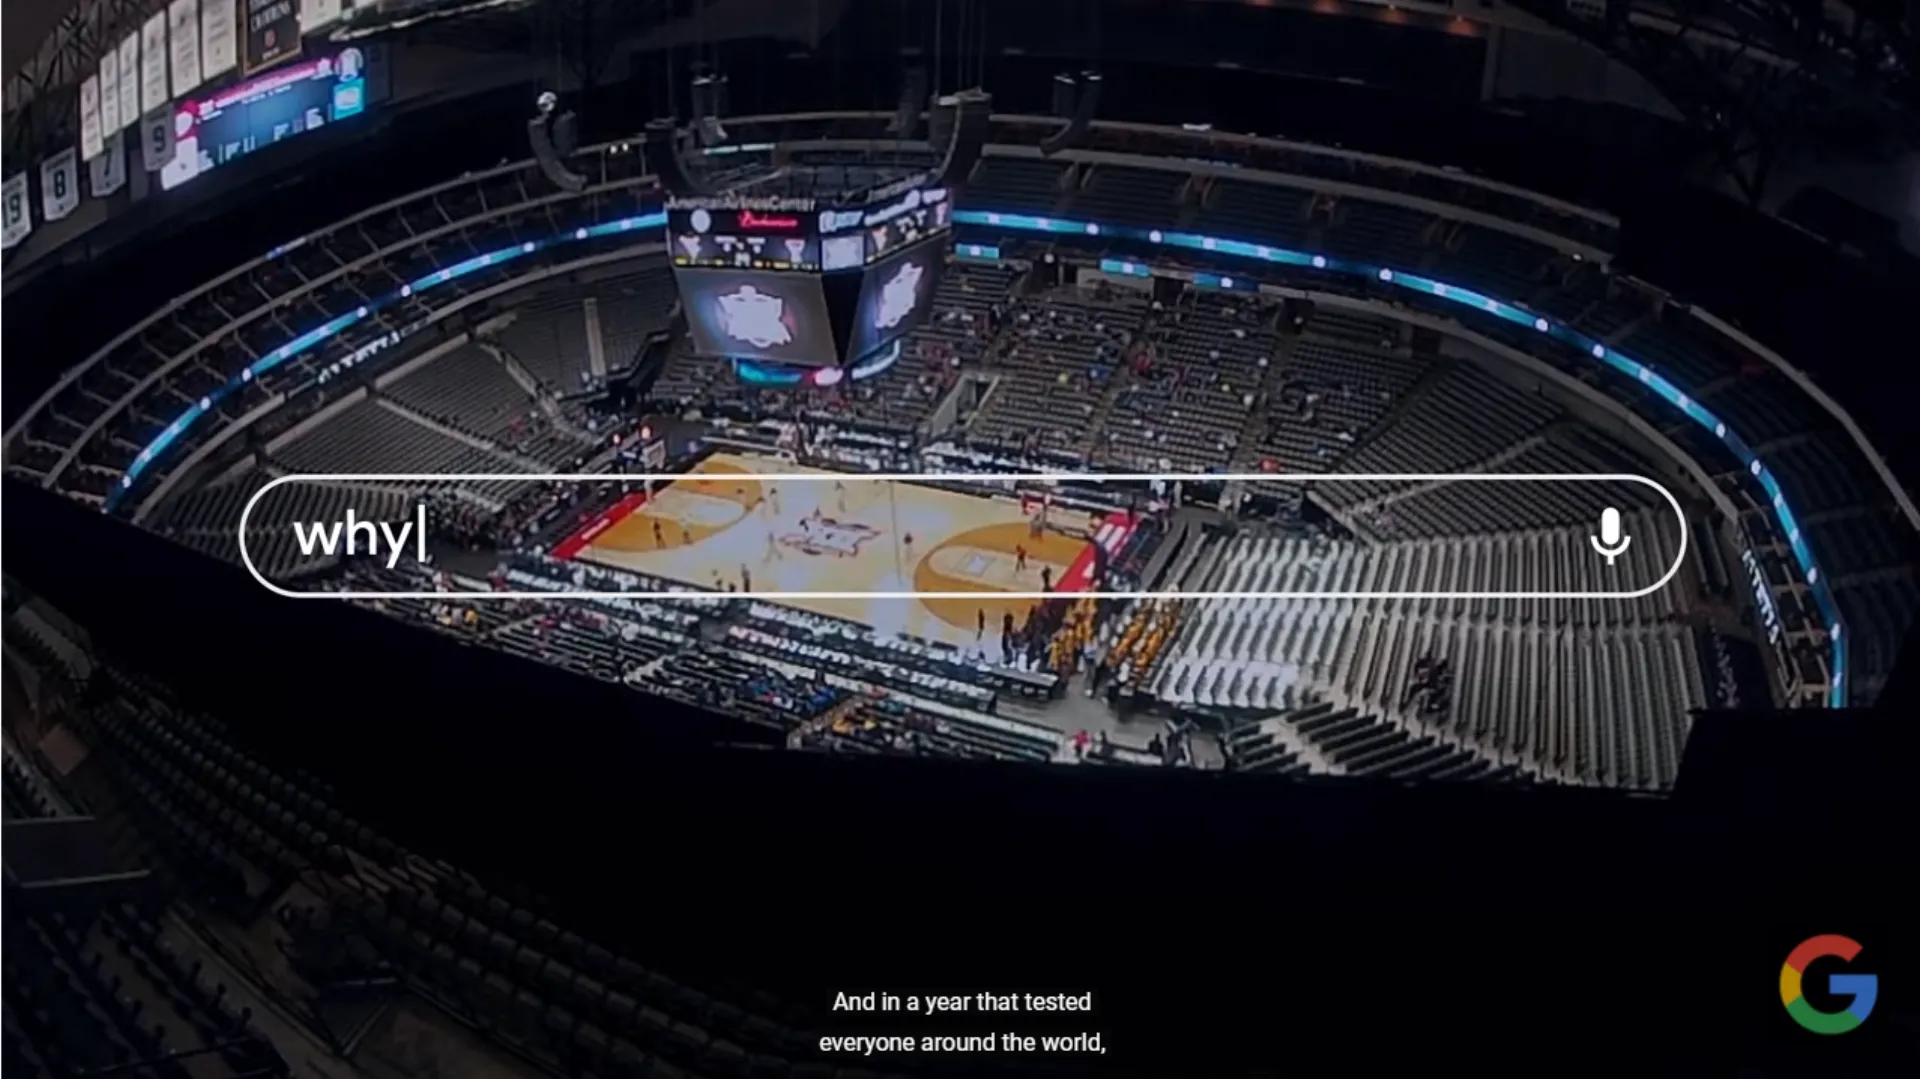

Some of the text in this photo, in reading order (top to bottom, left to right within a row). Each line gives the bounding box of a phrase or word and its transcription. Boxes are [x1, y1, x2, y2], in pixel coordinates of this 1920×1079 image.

[153, 125, 166, 153] 9
[54, 169, 66, 199] 8
[1, 193, 22, 230] 19
